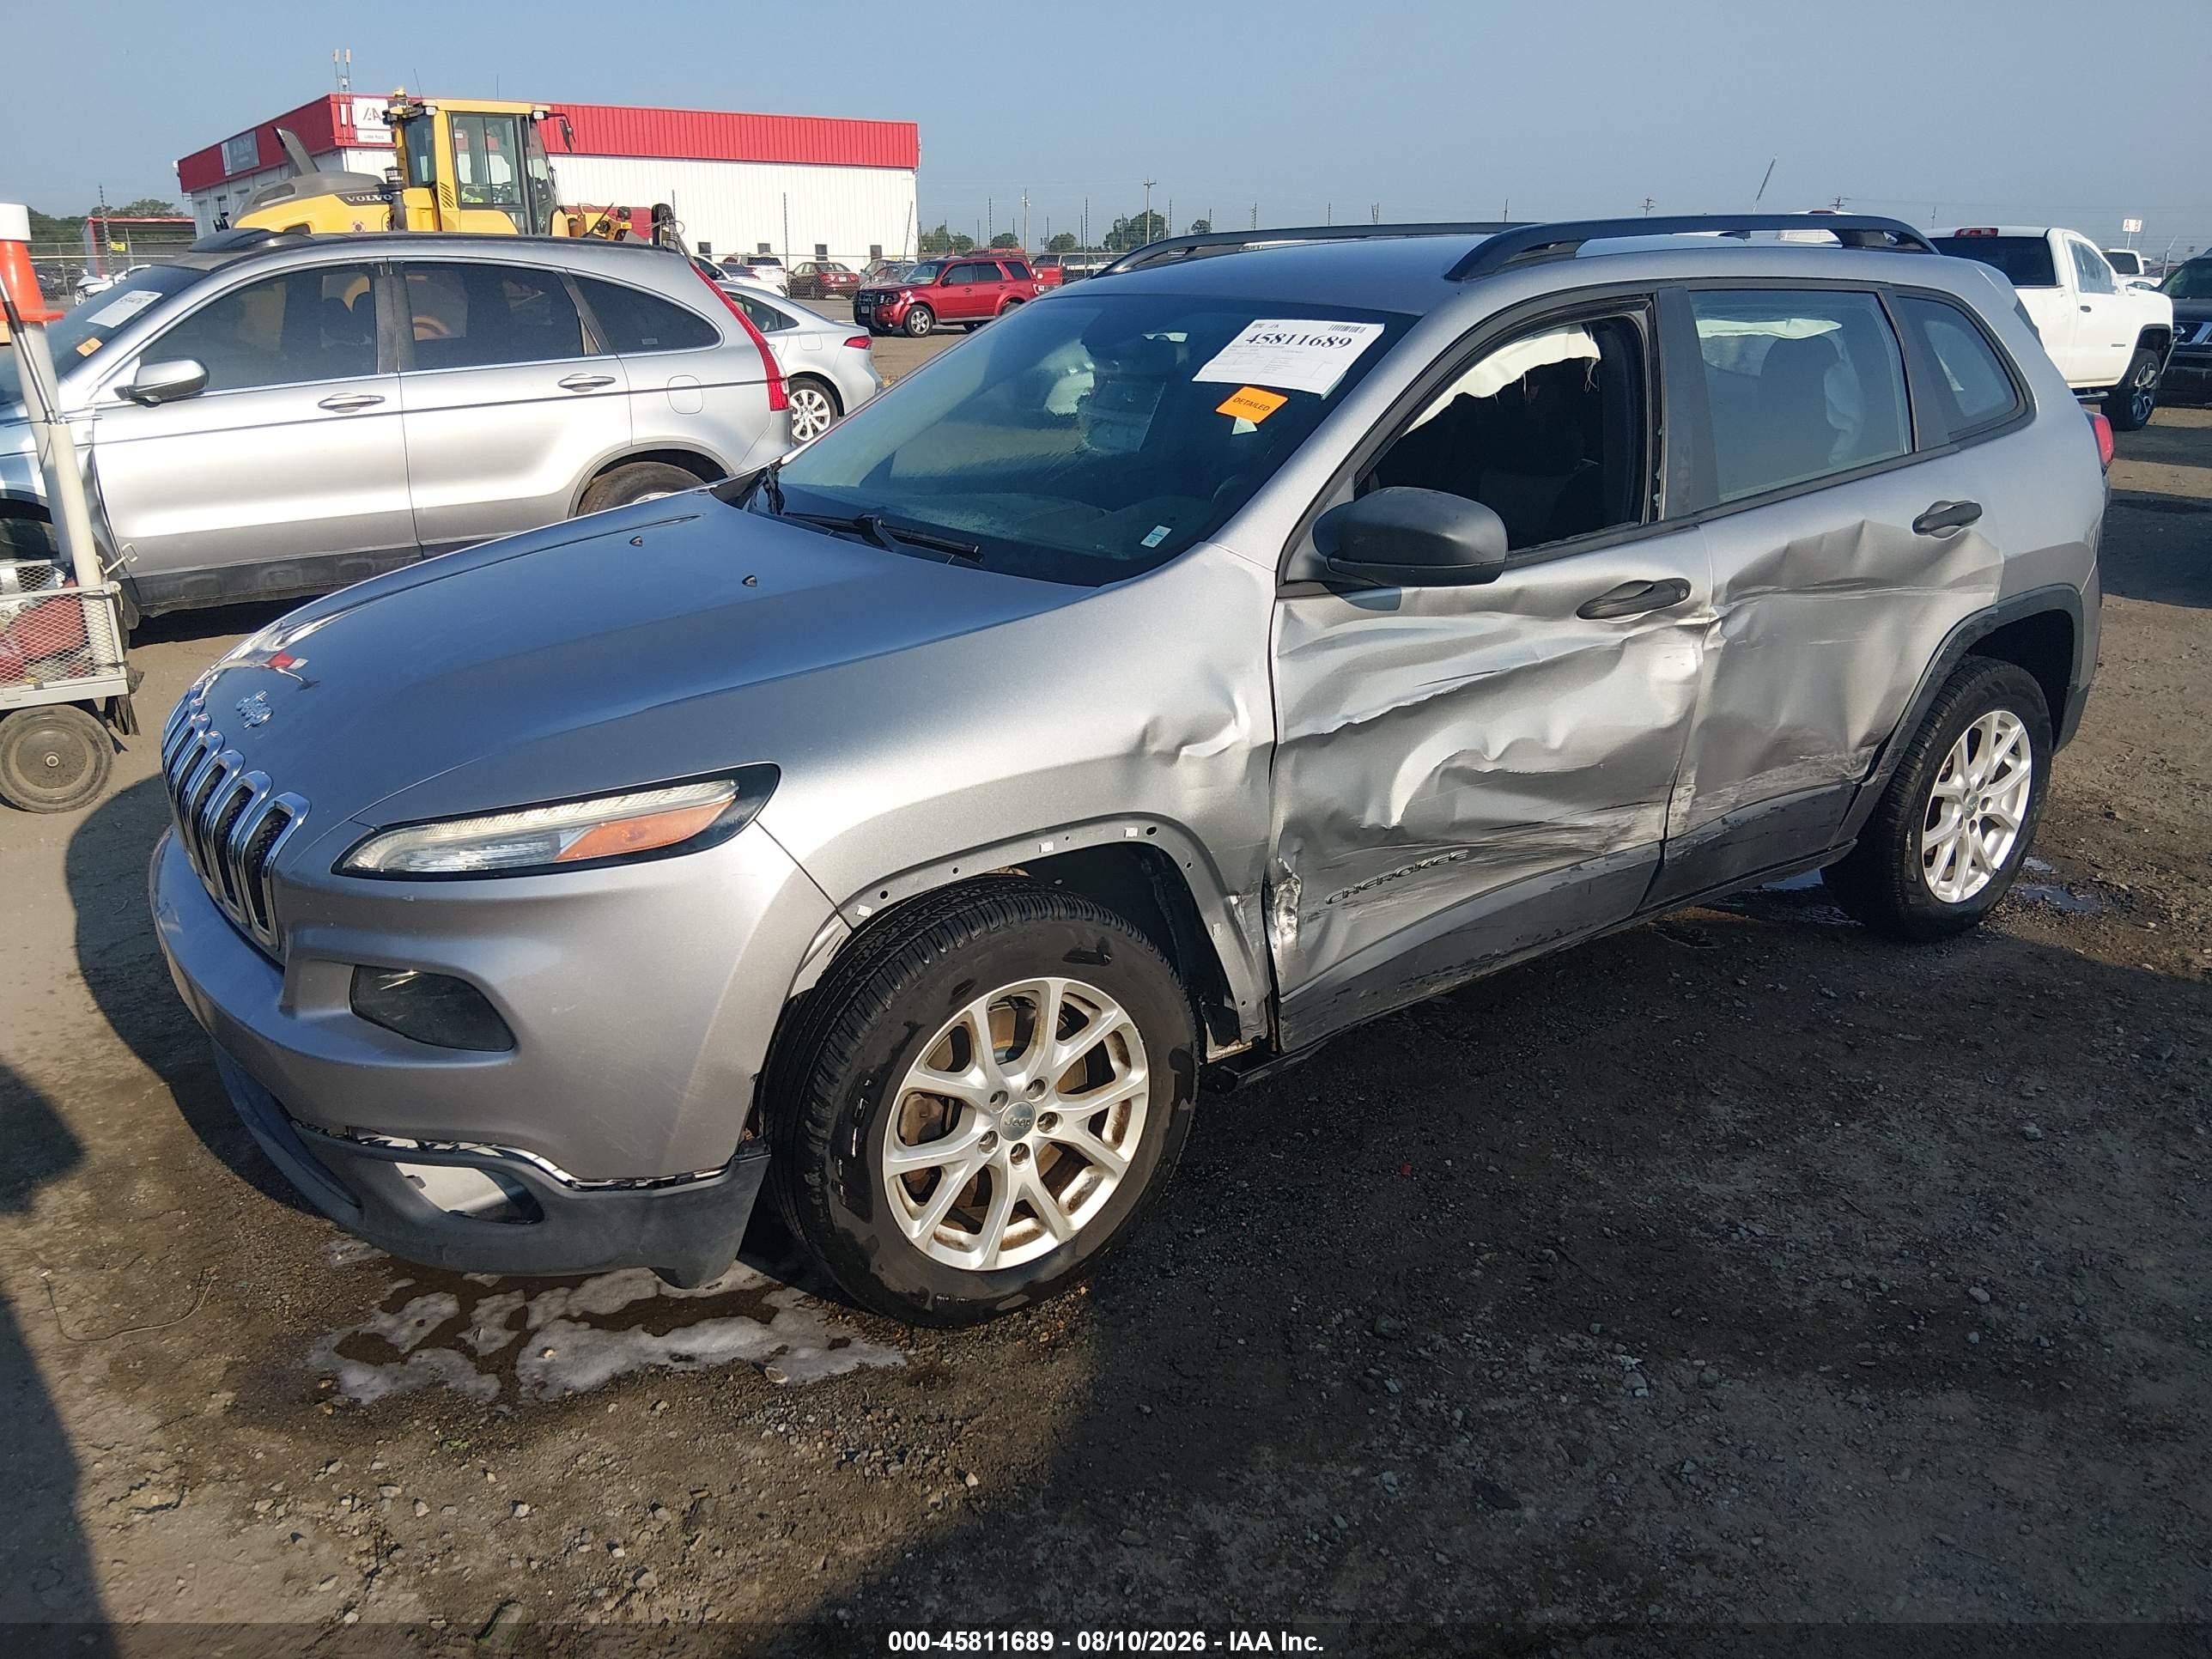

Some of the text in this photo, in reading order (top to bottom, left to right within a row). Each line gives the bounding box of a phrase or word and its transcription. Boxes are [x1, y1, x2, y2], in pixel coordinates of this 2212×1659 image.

[345, 193, 393, 203] VOLVO
[1245, 332, 1353, 349] 45811689
[1232, 397, 1271, 411] DETAILED
[1325, 848, 1469, 904] CHEROKEE
[1004, 1117, 1031, 1128] Jeep
